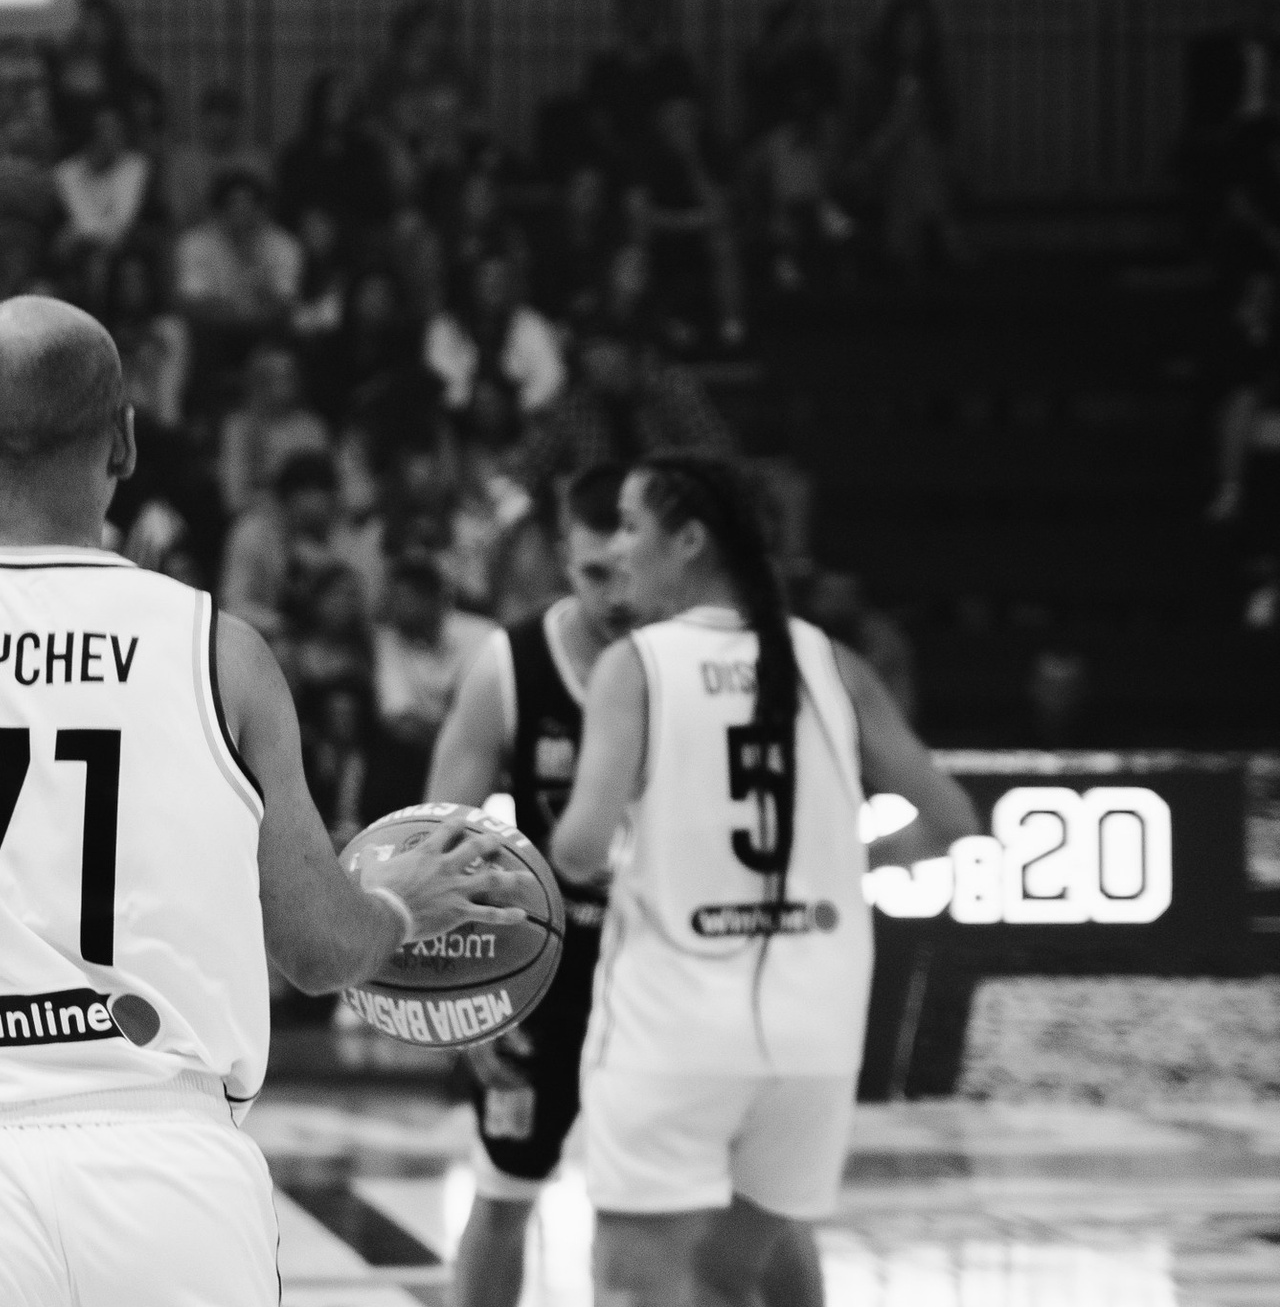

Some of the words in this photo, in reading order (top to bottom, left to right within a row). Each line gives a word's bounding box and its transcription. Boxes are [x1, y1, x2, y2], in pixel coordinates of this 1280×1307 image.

[726, 726, 794, 874] 5
[412, 933, 496, 958] LUCKY
[426, 989, 513, 1042] MEDIA
